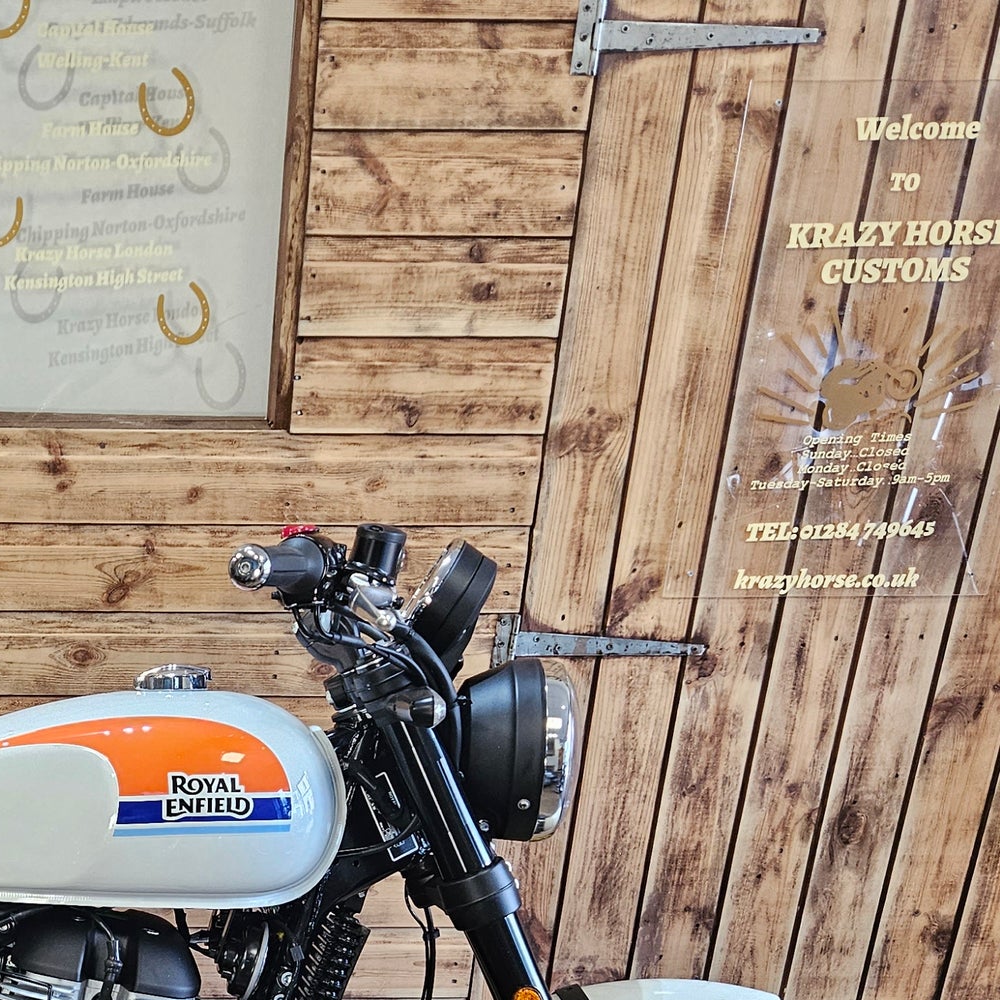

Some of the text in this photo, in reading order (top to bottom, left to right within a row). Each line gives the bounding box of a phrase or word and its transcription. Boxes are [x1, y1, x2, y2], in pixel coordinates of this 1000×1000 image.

[37, 51, 151, 72] Welling-Kent
[41, 121, 88, 138] Farm
[88, 119, 140, 136] House
[855, 113, 982, 142] Welcome
[53, 152, 213, 174] Norton-Oxfordshire
[889, 172, 921, 192] TO
[785, 220, 903, 249] KRAZY
[14, 240, 174, 267] Krazy Horse London
[3, 266, 184, 292] Kensington High Street
[820, 255, 972, 285] CUSTOMS
[802, 431, 913, 447] Opening Times
[862, 519, 937, 541] 749645
[733, 565, 920, 595] krazyhorse.co.uk
[171, 775, 242, 796] ROYAL
[165, 797, 251, 818] ENFIELD
